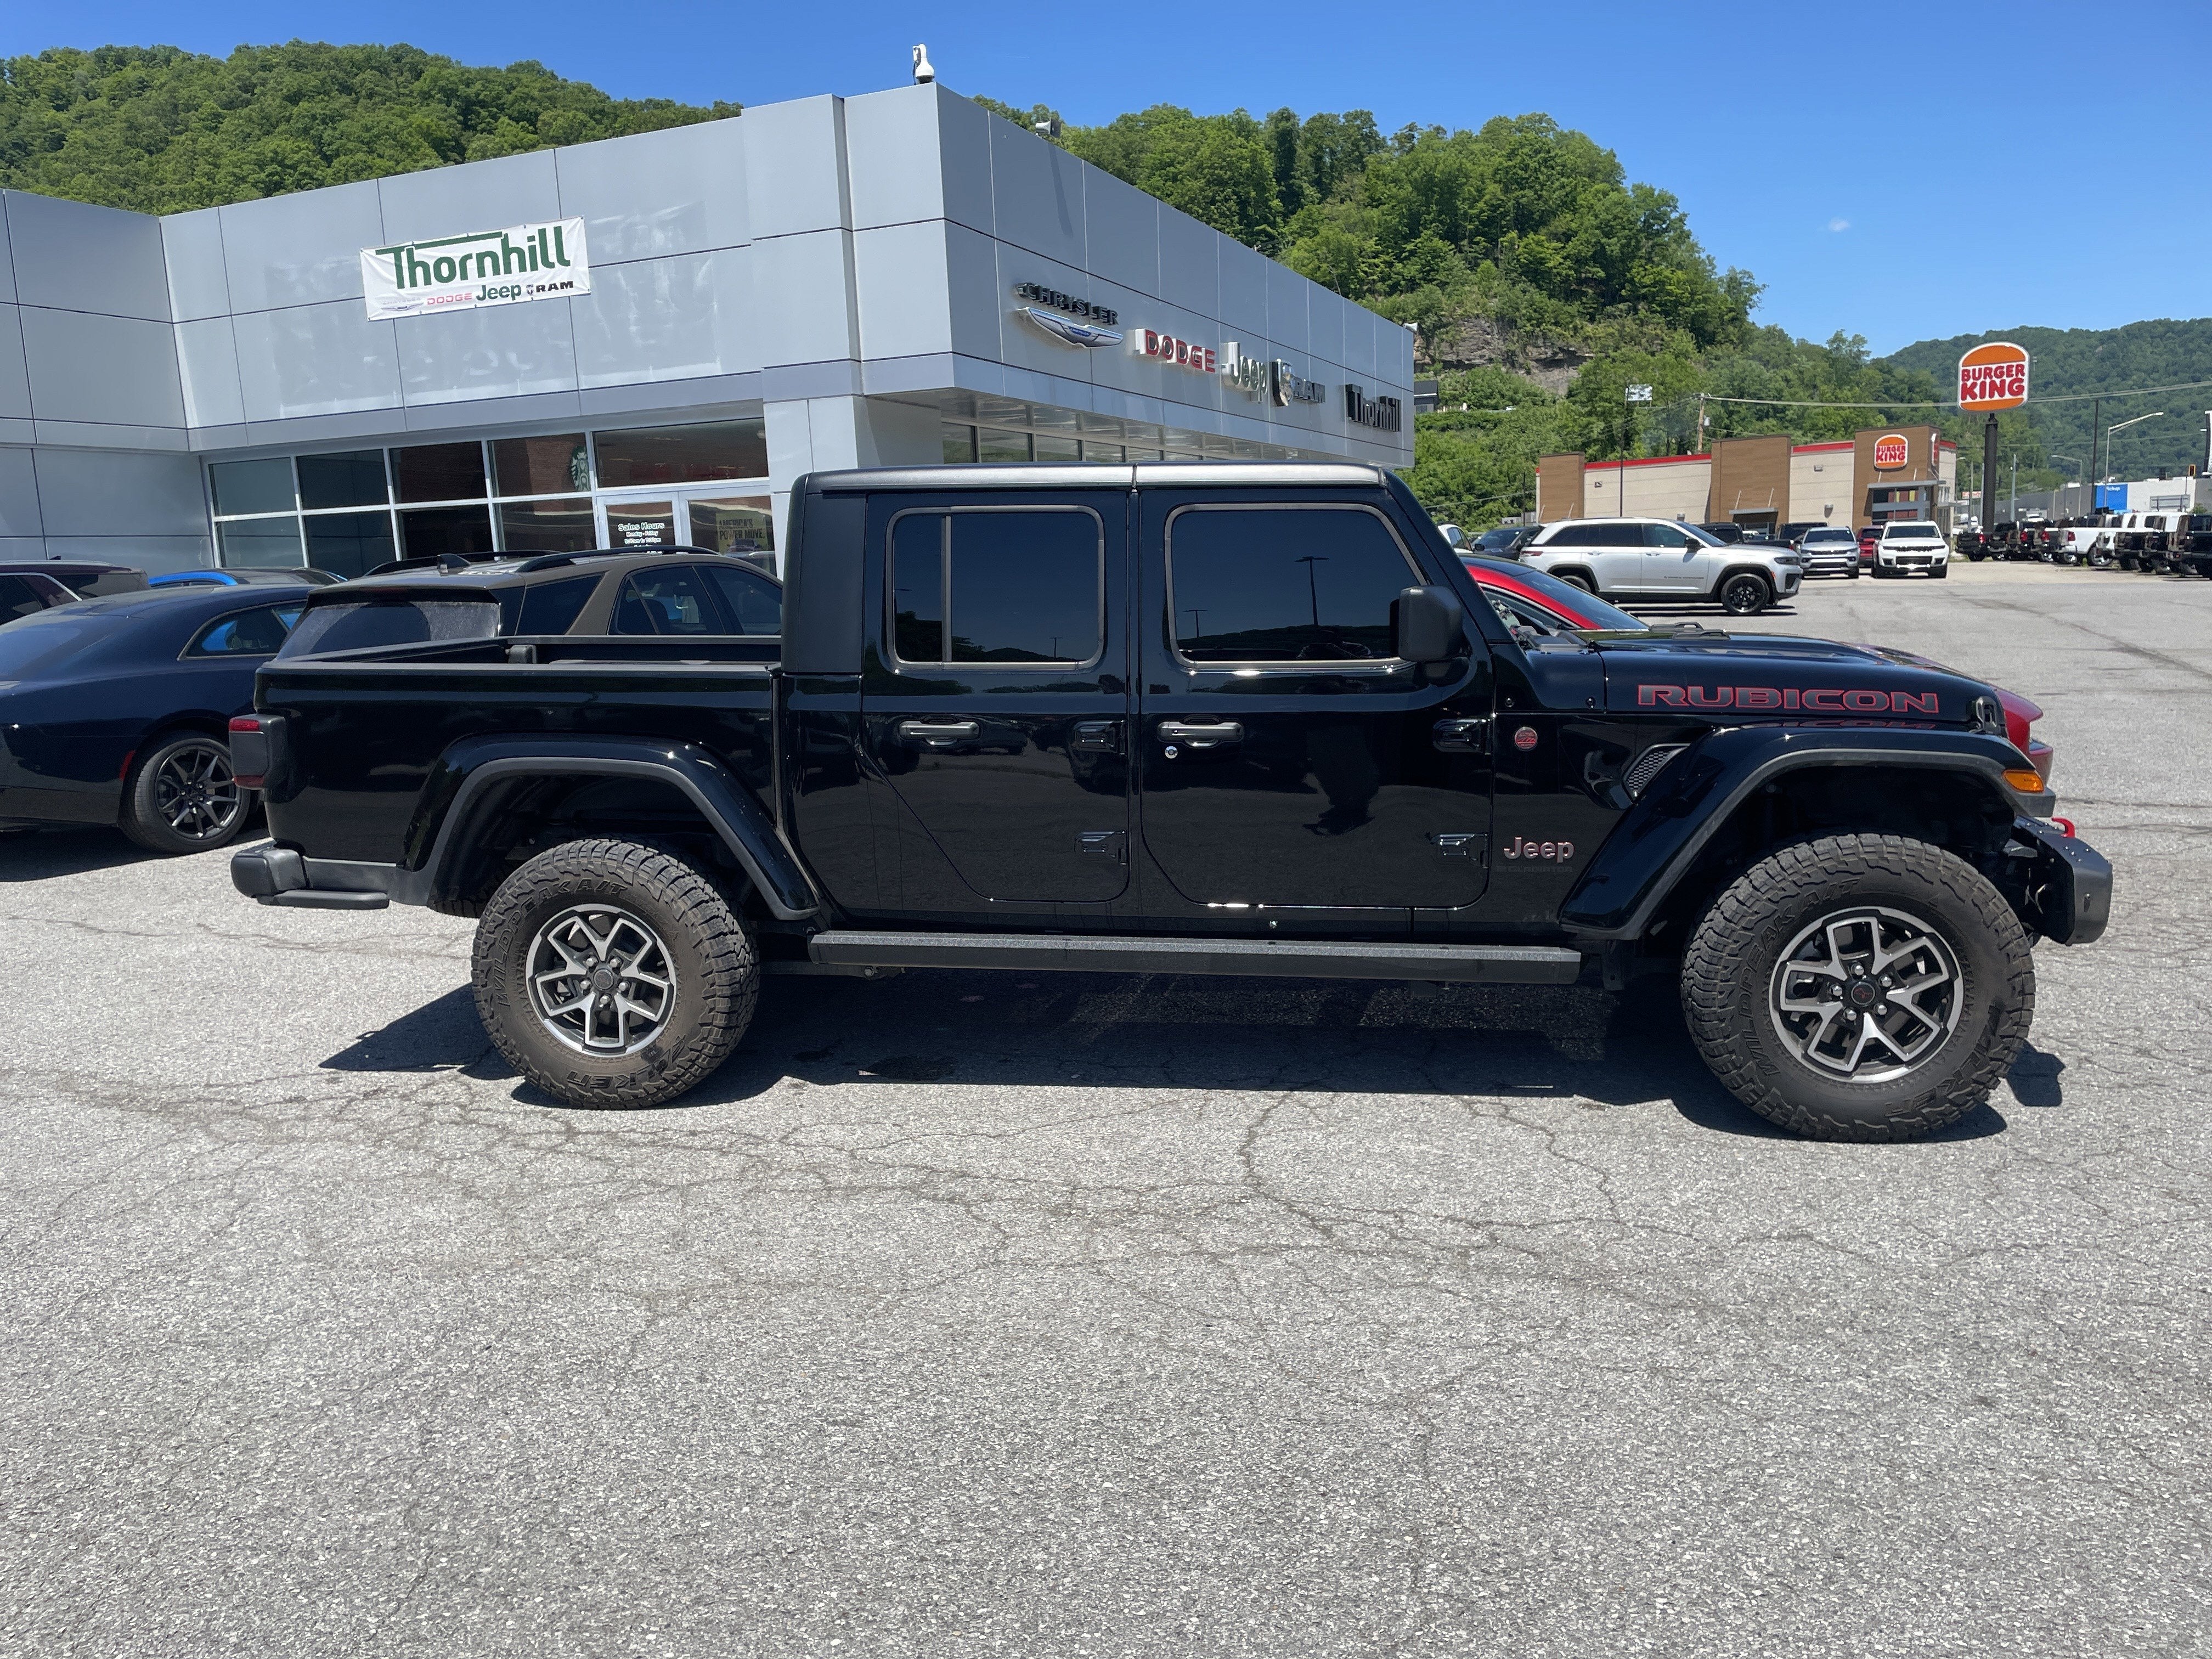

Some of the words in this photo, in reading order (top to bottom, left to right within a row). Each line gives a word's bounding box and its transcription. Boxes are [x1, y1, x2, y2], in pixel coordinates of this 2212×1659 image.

[375, 225, 571, 290] Thornhill
[427, 292, 472, 306] DODGE
[476, 283, 522, 301] Jeep
[535, 280, 574, 294] RAM
[1017, 282, 1119, 325] CHRYSLER
[1135, 328, 1216, 373] DODGE
[1221, 341, 1268, 404] Jeep
[1961, 363, 2025, 382] BURGER
[1960, 377, 2025, 401] KING
[1345, 384, 1402, 432] Thornhill
[1875, 451, 1906, 462] KING
[1876, 444, 1906, 454] BURGER
[618, 523, 640, 532] Sales
[641, 522, 665, 530] Hours
[719, 518, 753, 528] AMERICA'S
[719, 529, 743, 540] POWER
[1638, 684, 1939, 714] RUBICON
[1504, 837, 1575, 864] Jeep
[494, 878, 571, 1008] WILDPEAK
[1737, 904, 1796, 1075] WILDPEAK
